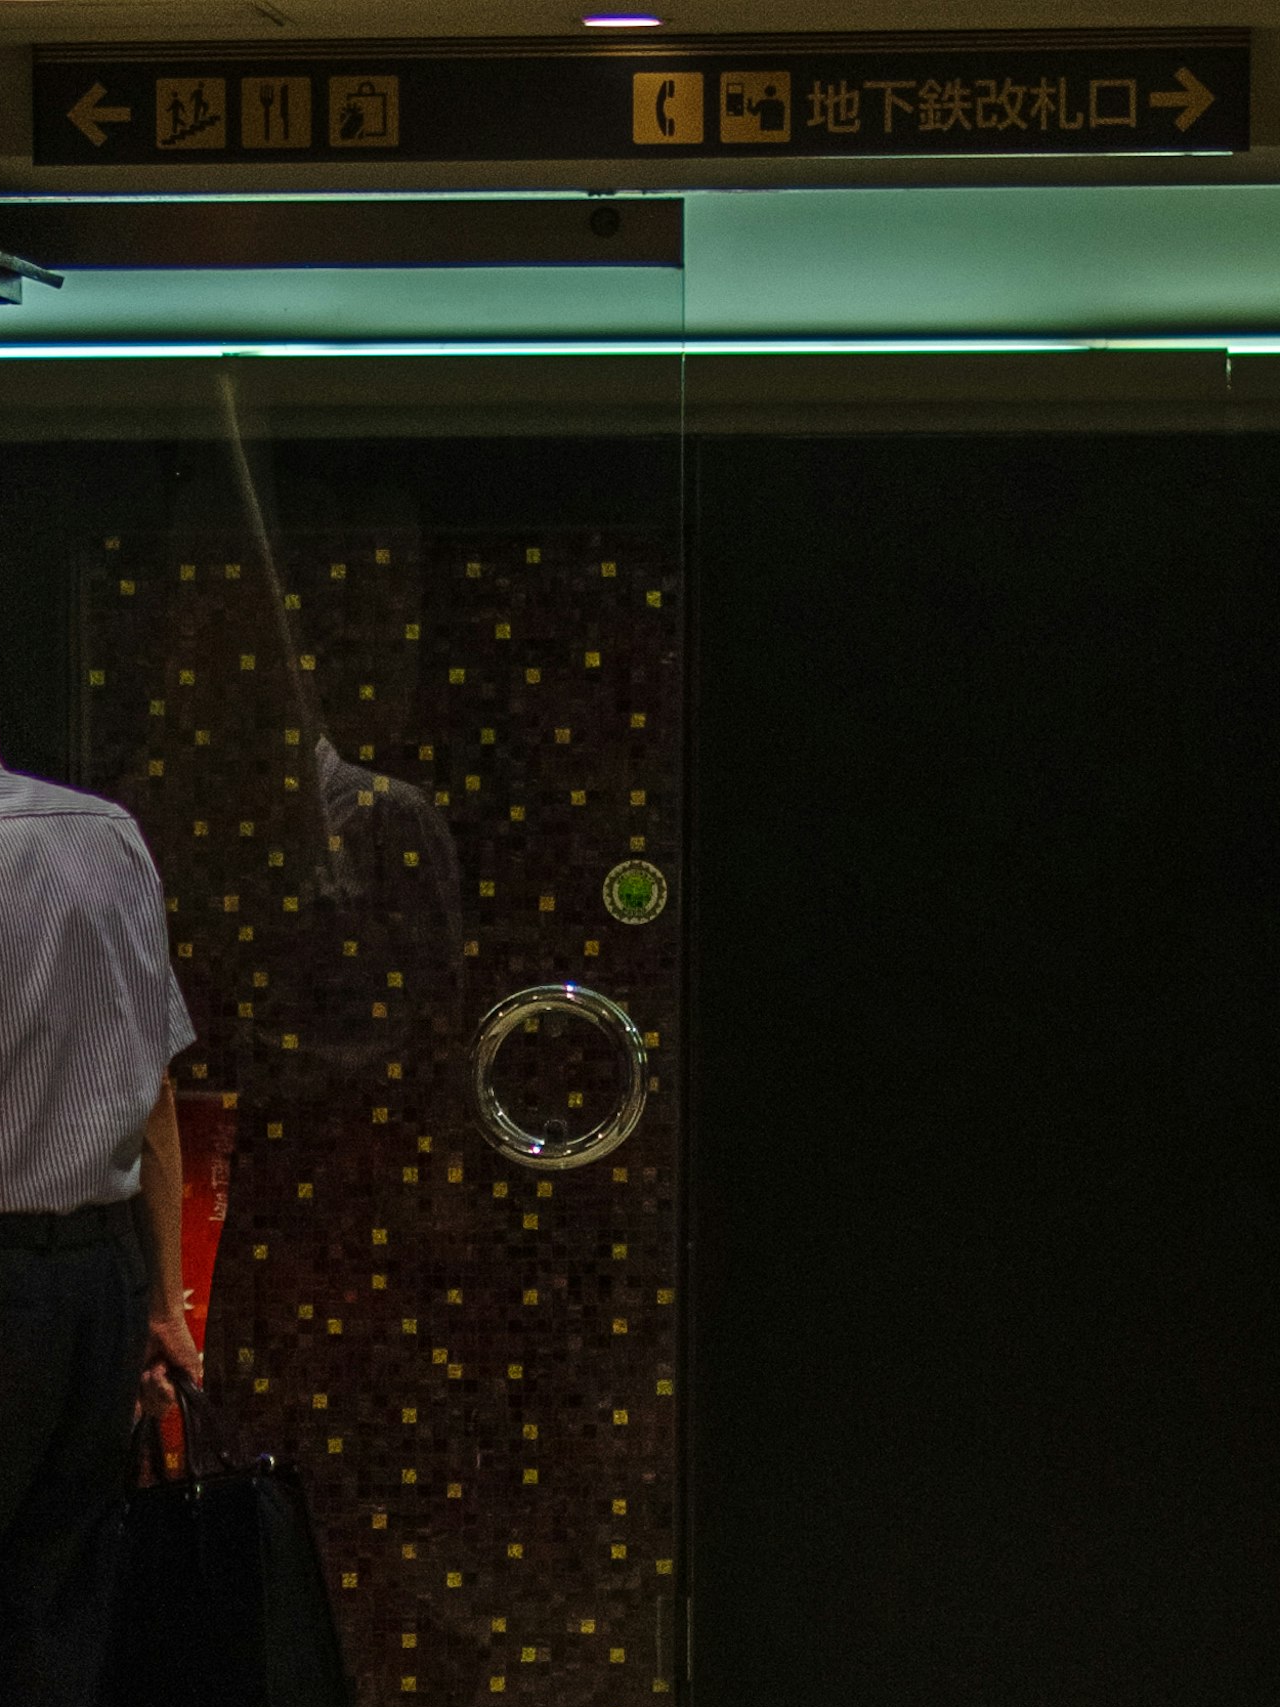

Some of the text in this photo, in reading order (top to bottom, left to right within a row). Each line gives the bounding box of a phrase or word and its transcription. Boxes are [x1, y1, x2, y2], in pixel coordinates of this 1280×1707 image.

[807, 77, 1136, 134] 地下鉄改札口
